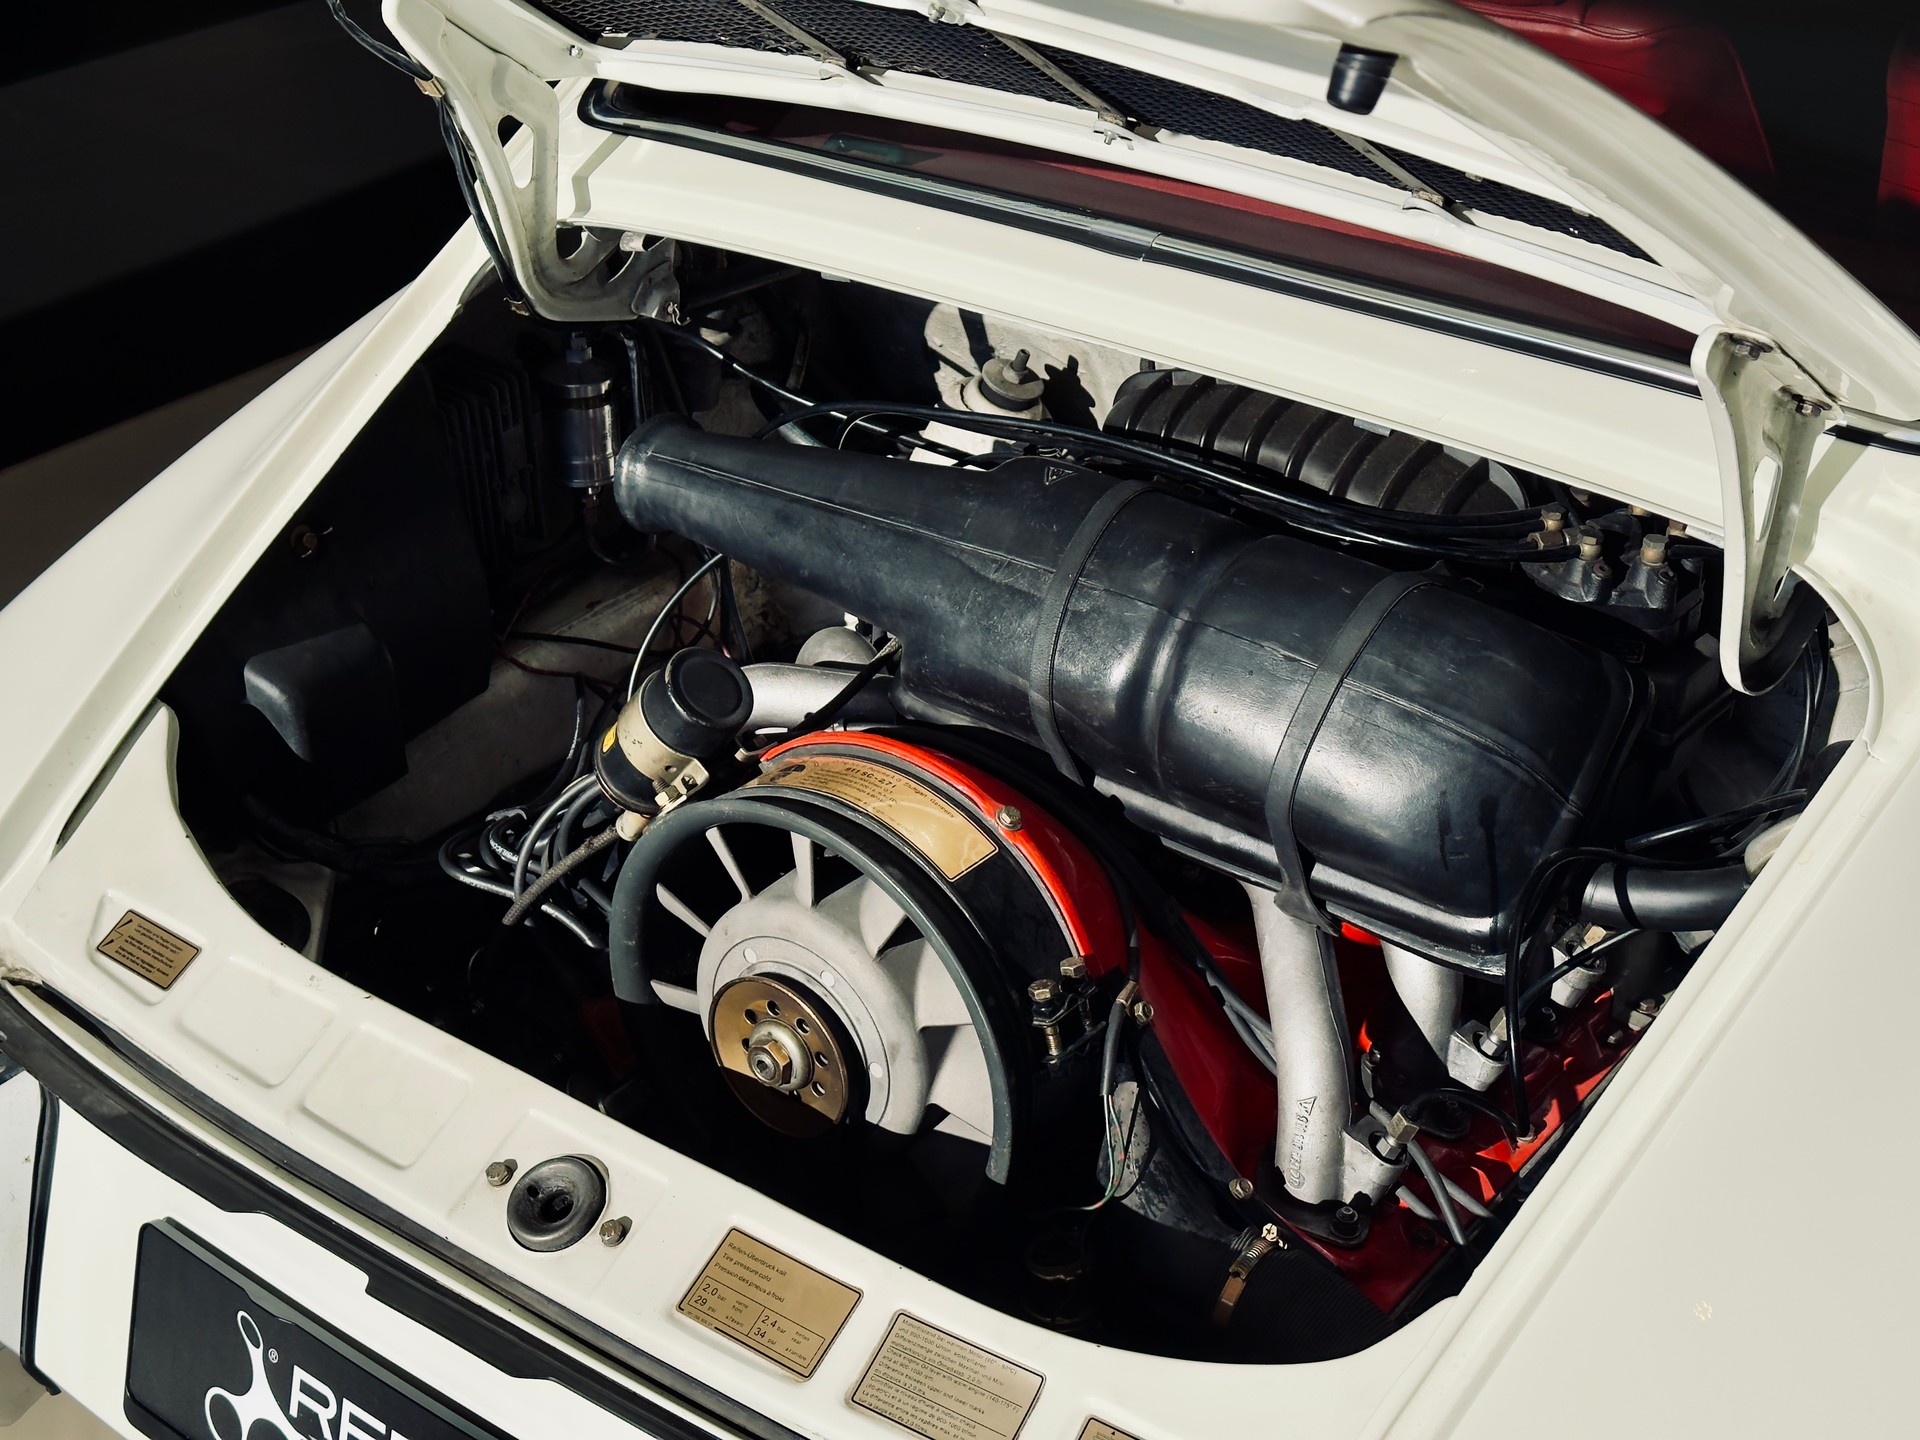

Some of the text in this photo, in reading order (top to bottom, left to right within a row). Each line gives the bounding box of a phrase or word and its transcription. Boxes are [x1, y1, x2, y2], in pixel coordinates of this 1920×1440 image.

[733, 1259, 759, 1276] pressure
[713, 1261, 740, 1279] Pression
[737, 1274, 750, 1284] des
[747, 1280, 767, 1294] pneus
[693, 1294, 708, 1307] 29
[752, 1326, 767, 1339] 34
